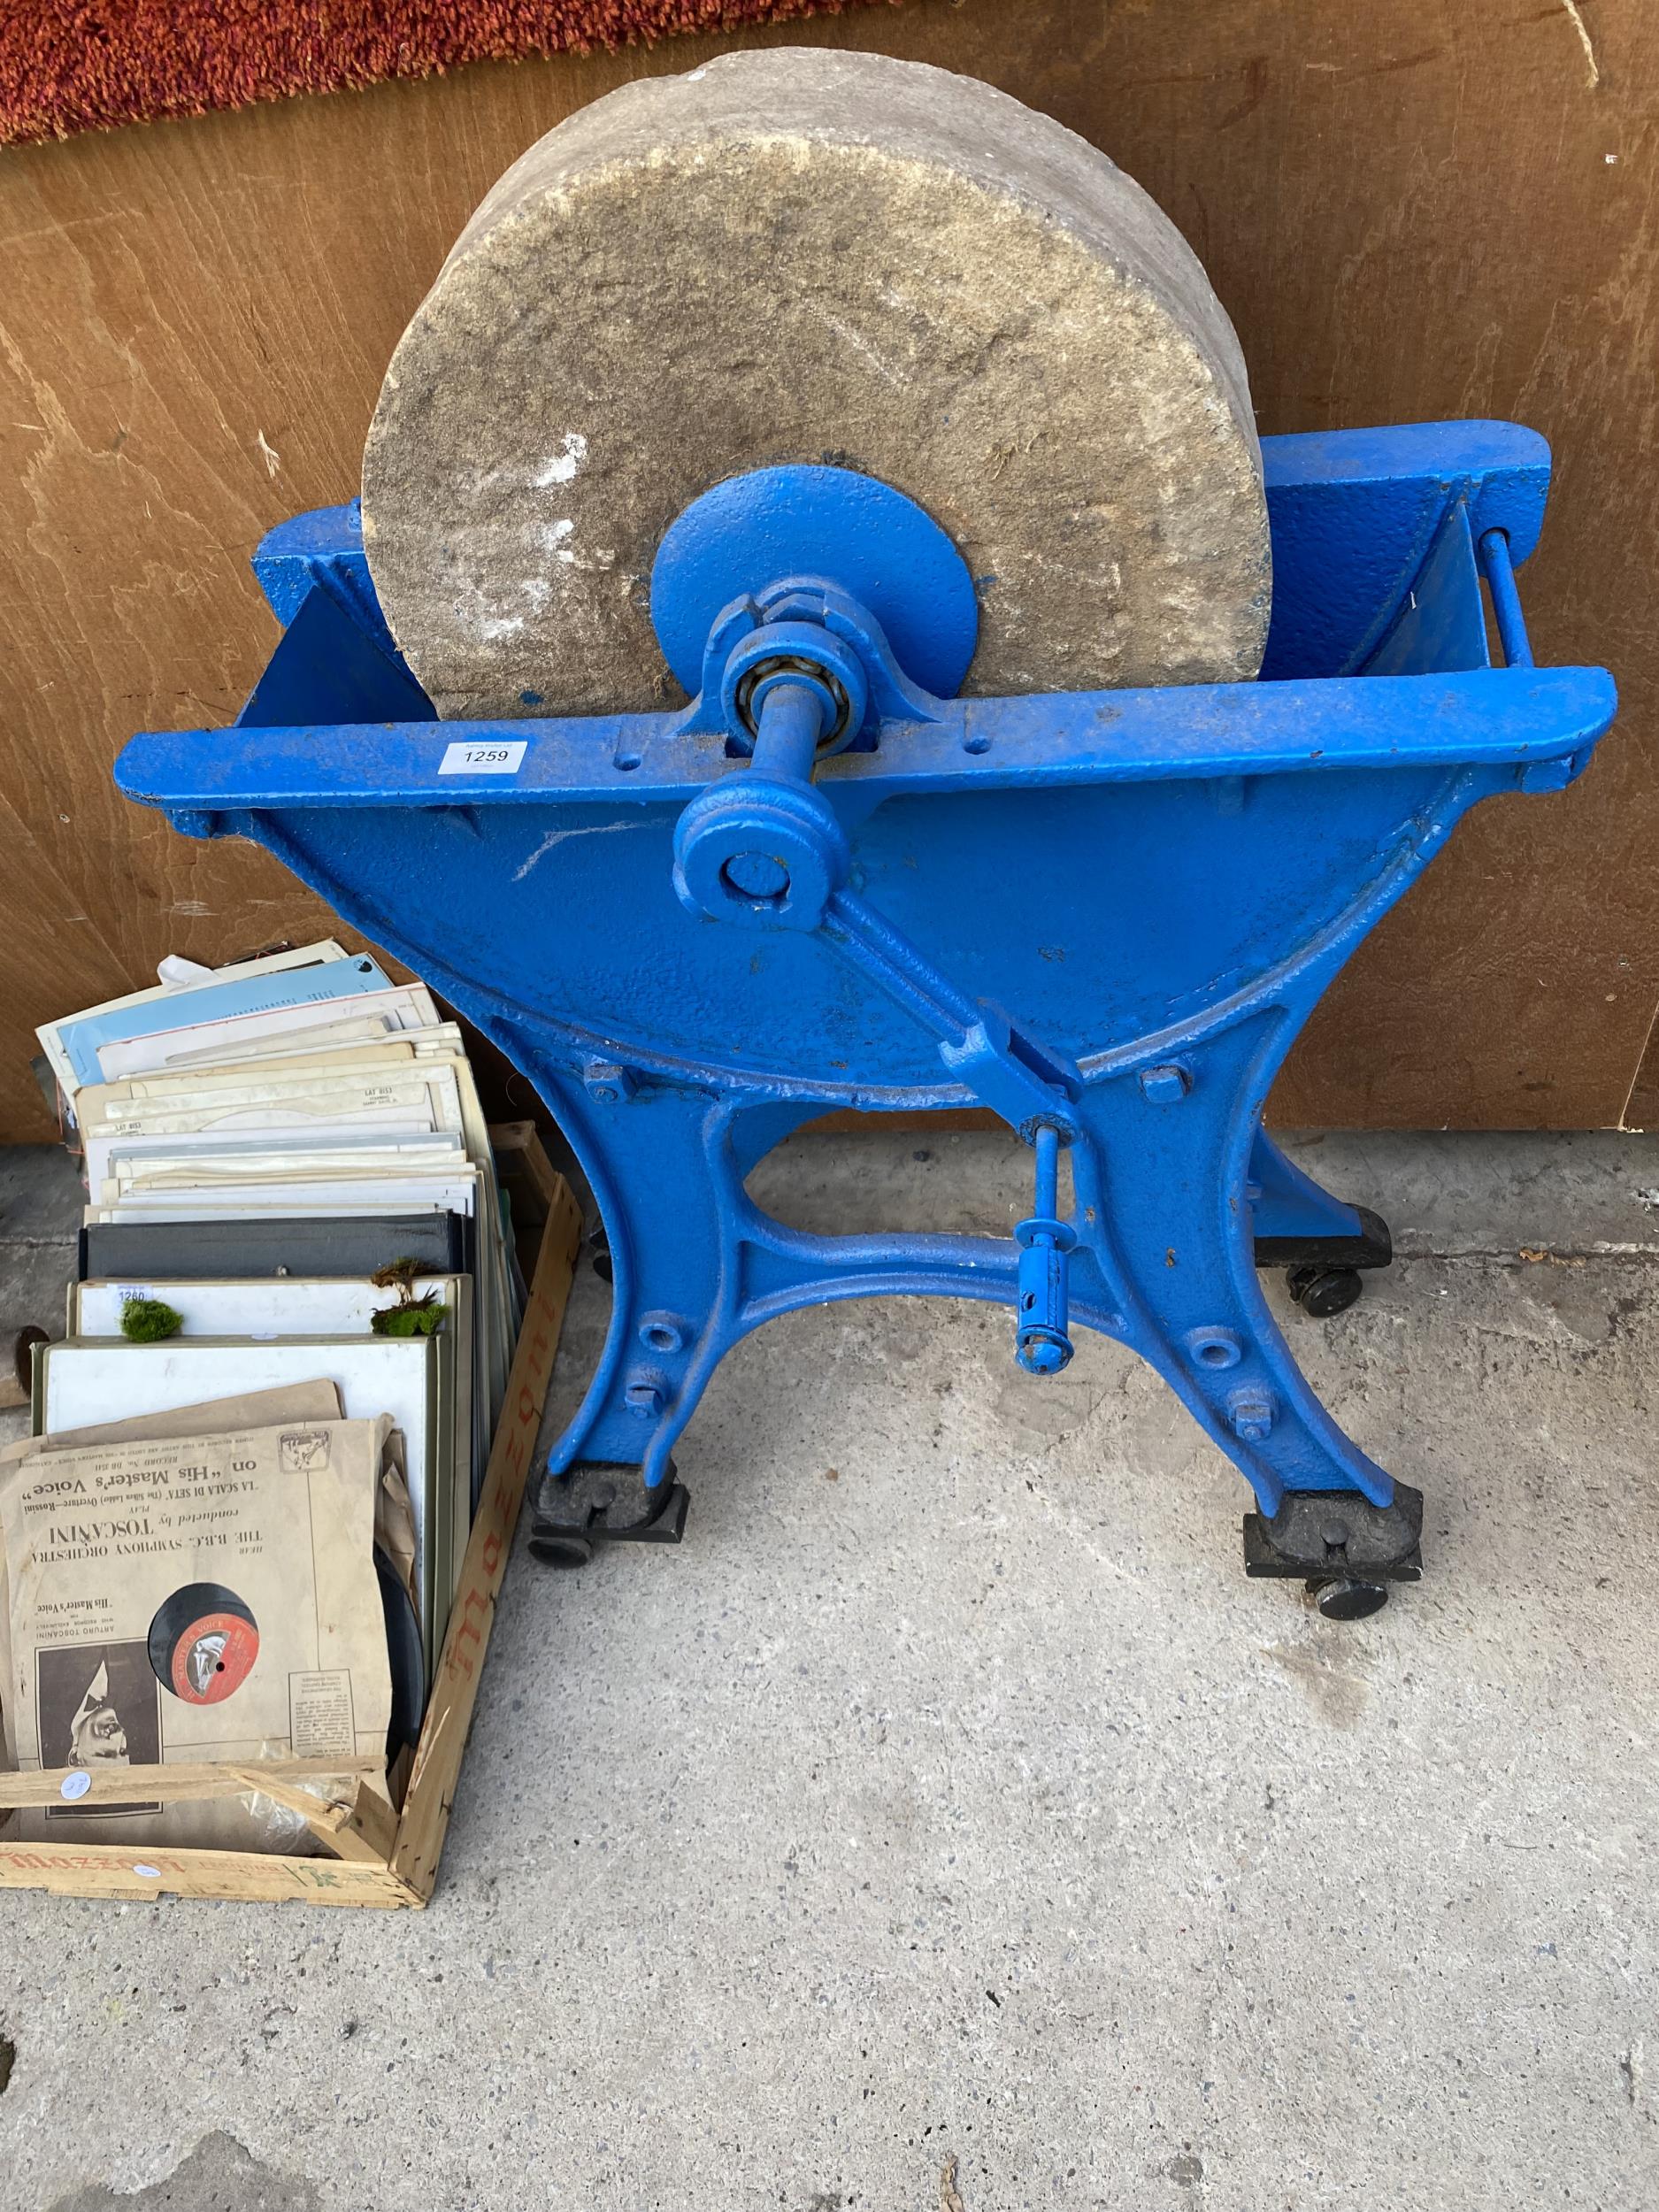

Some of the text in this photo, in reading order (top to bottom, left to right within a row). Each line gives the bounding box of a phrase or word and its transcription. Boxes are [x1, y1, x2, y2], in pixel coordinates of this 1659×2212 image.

[465, 750, 509, 762] 1259
[119, 1291, 145, 1302] 1260
[111, 1462, 122, 1471] DB
[144, 1456, 178, 1466] RECORD
[22, 1460, 257, 1500] on "His Master's Voice"
[194, 1486, 204, 1497] DI
[208, 1482, 239, 1495] SCALA
[101, 1494, 123, 1505] Ladder)
[126, 1494, 144, 1502] Silken
[147, 1490, 162, 1501] (The
[129, 1505, 150, 1514] PLAY
[49, 1509, 239, 1544] conducted by TOSCANINI
[32, 1531, 262, 1563] THE B.B.C. SYMPHONY ORCHESTRA
[239, 1546, 262, 1555] HEAR
[60, 1600, 93, 1612] Master's
[197, 1619, 225, 1632] VOICE
[36, 1625, 113, 1640] ARTURO TOSCANINI
